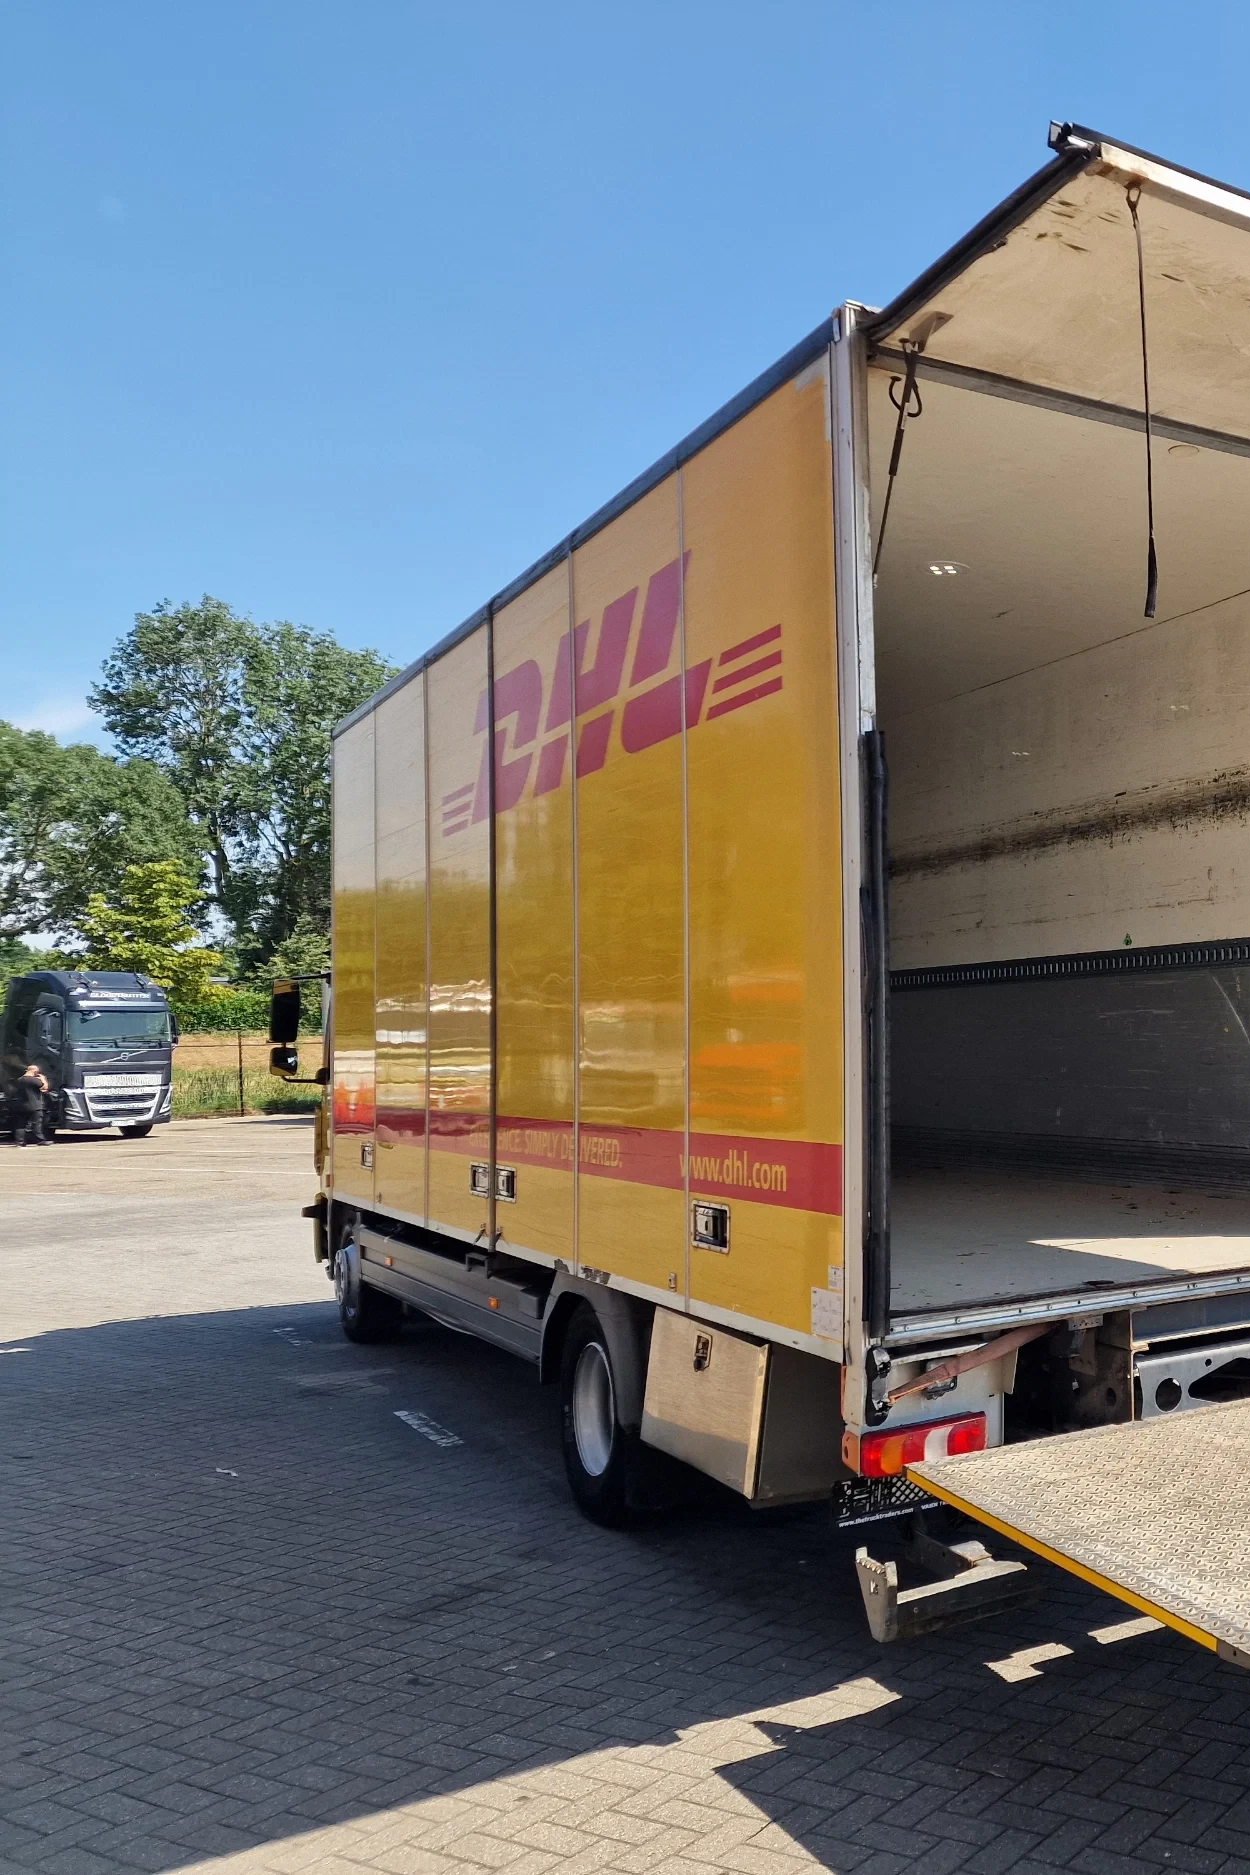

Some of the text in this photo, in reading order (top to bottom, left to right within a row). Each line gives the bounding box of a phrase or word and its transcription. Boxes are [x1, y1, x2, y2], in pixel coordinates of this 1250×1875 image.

[471, 549, 712, 826] DHL
[524, 1130, 560, 1158] SIMPLY
[561, 1133, 623, 1168] DEIVERED.
[679, 1149, 787, 1192] www.dhl.com
